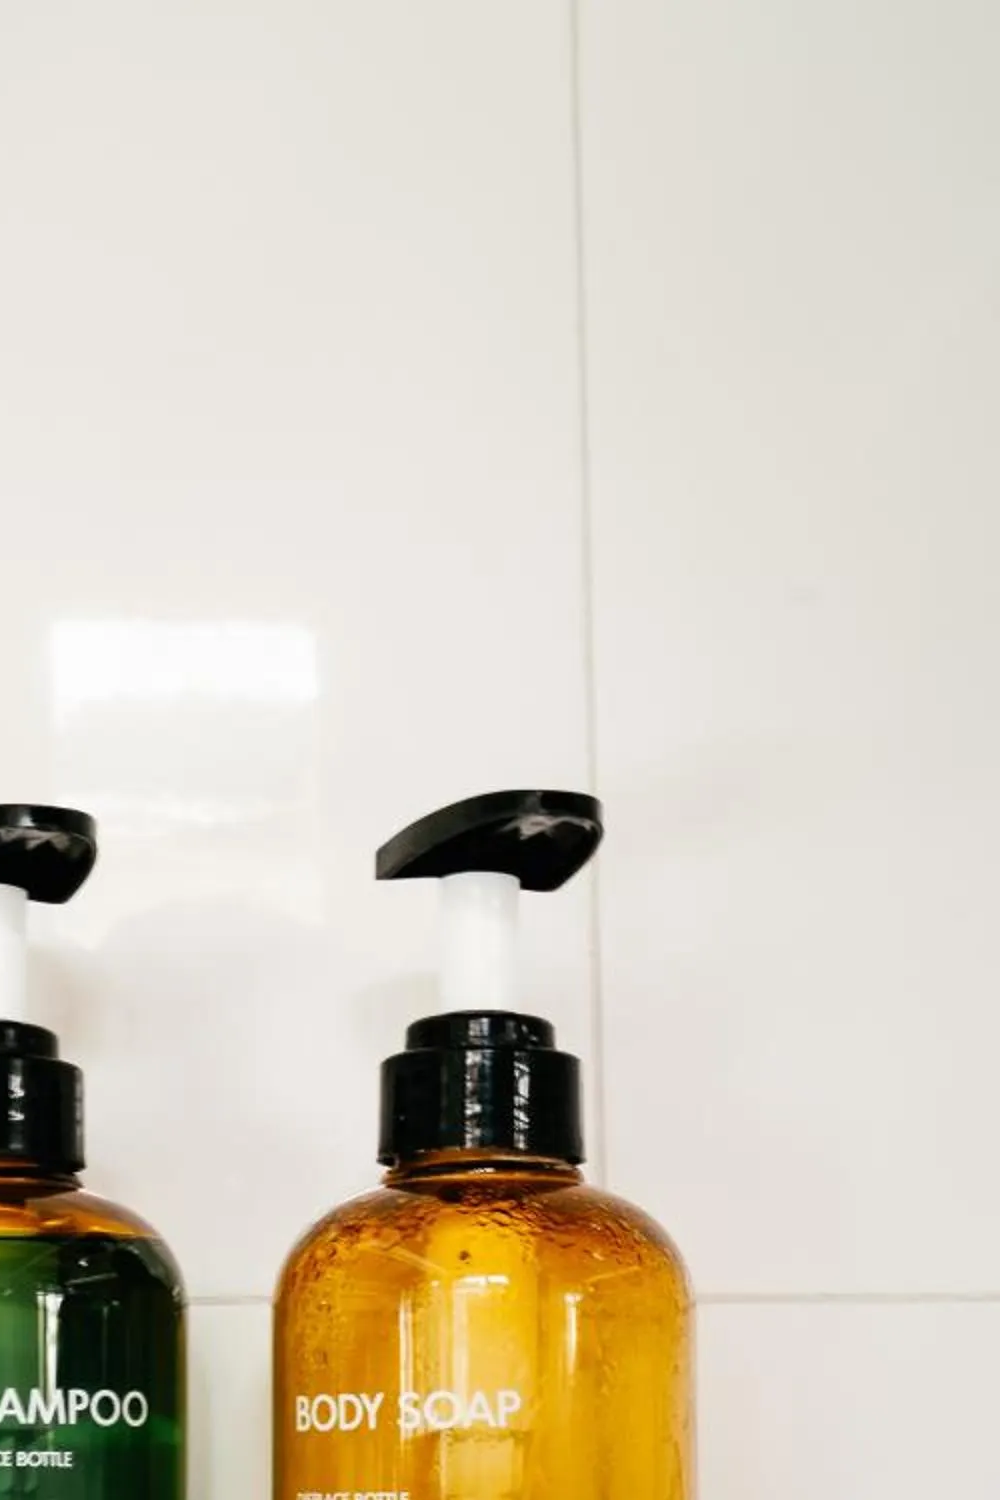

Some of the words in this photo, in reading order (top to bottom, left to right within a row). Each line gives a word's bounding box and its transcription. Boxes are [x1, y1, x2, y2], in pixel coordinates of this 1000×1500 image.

[295, 1392, 384, 1432] BODY
[397, 1389, 522, 1429] SOAP
[15, 1450, 73, 1468] BOTTLE
